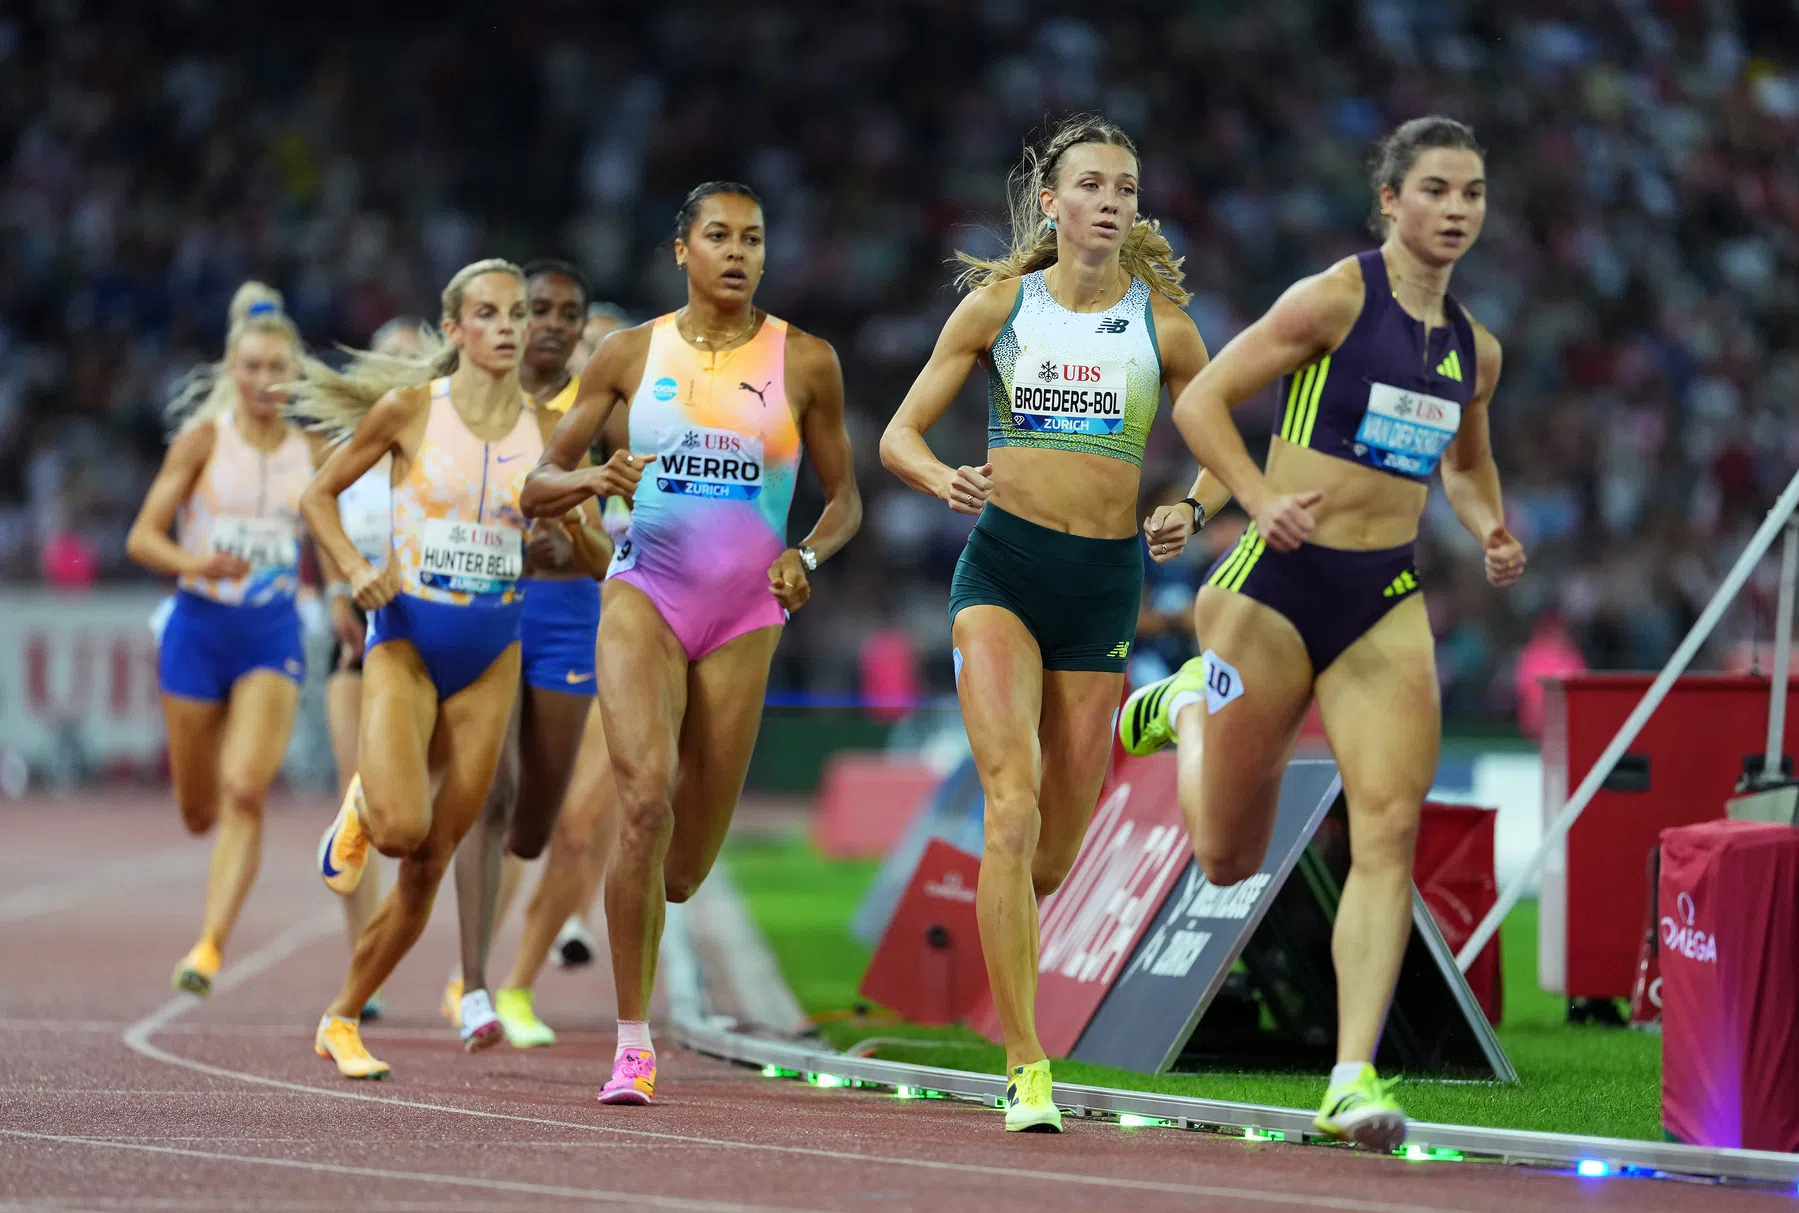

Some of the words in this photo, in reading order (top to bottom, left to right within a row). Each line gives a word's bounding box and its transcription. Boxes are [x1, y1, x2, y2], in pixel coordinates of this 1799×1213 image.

[1063, 364, 1101, 383] UBS
[1015, 387, 1121, 415] BROEDERS-BOL
[1416, 400, 1444, 421] UBS
[1043, 418, 1090, 431] ZURICH
[704, 434, 741, 453] UBS
[661, 455, 760, 481] WERRO
[685, 482, 730, 496] ZURICH
[472, 529, 504, 547] UBS
[617, 540, 632, 561] 9
[424, 547, 484, 573] HUNTER
[486, 555, 515, 577] BELL
[1210, 664, 1231, 697] 10
[1660, 916, 1718, 965] OMEGA
